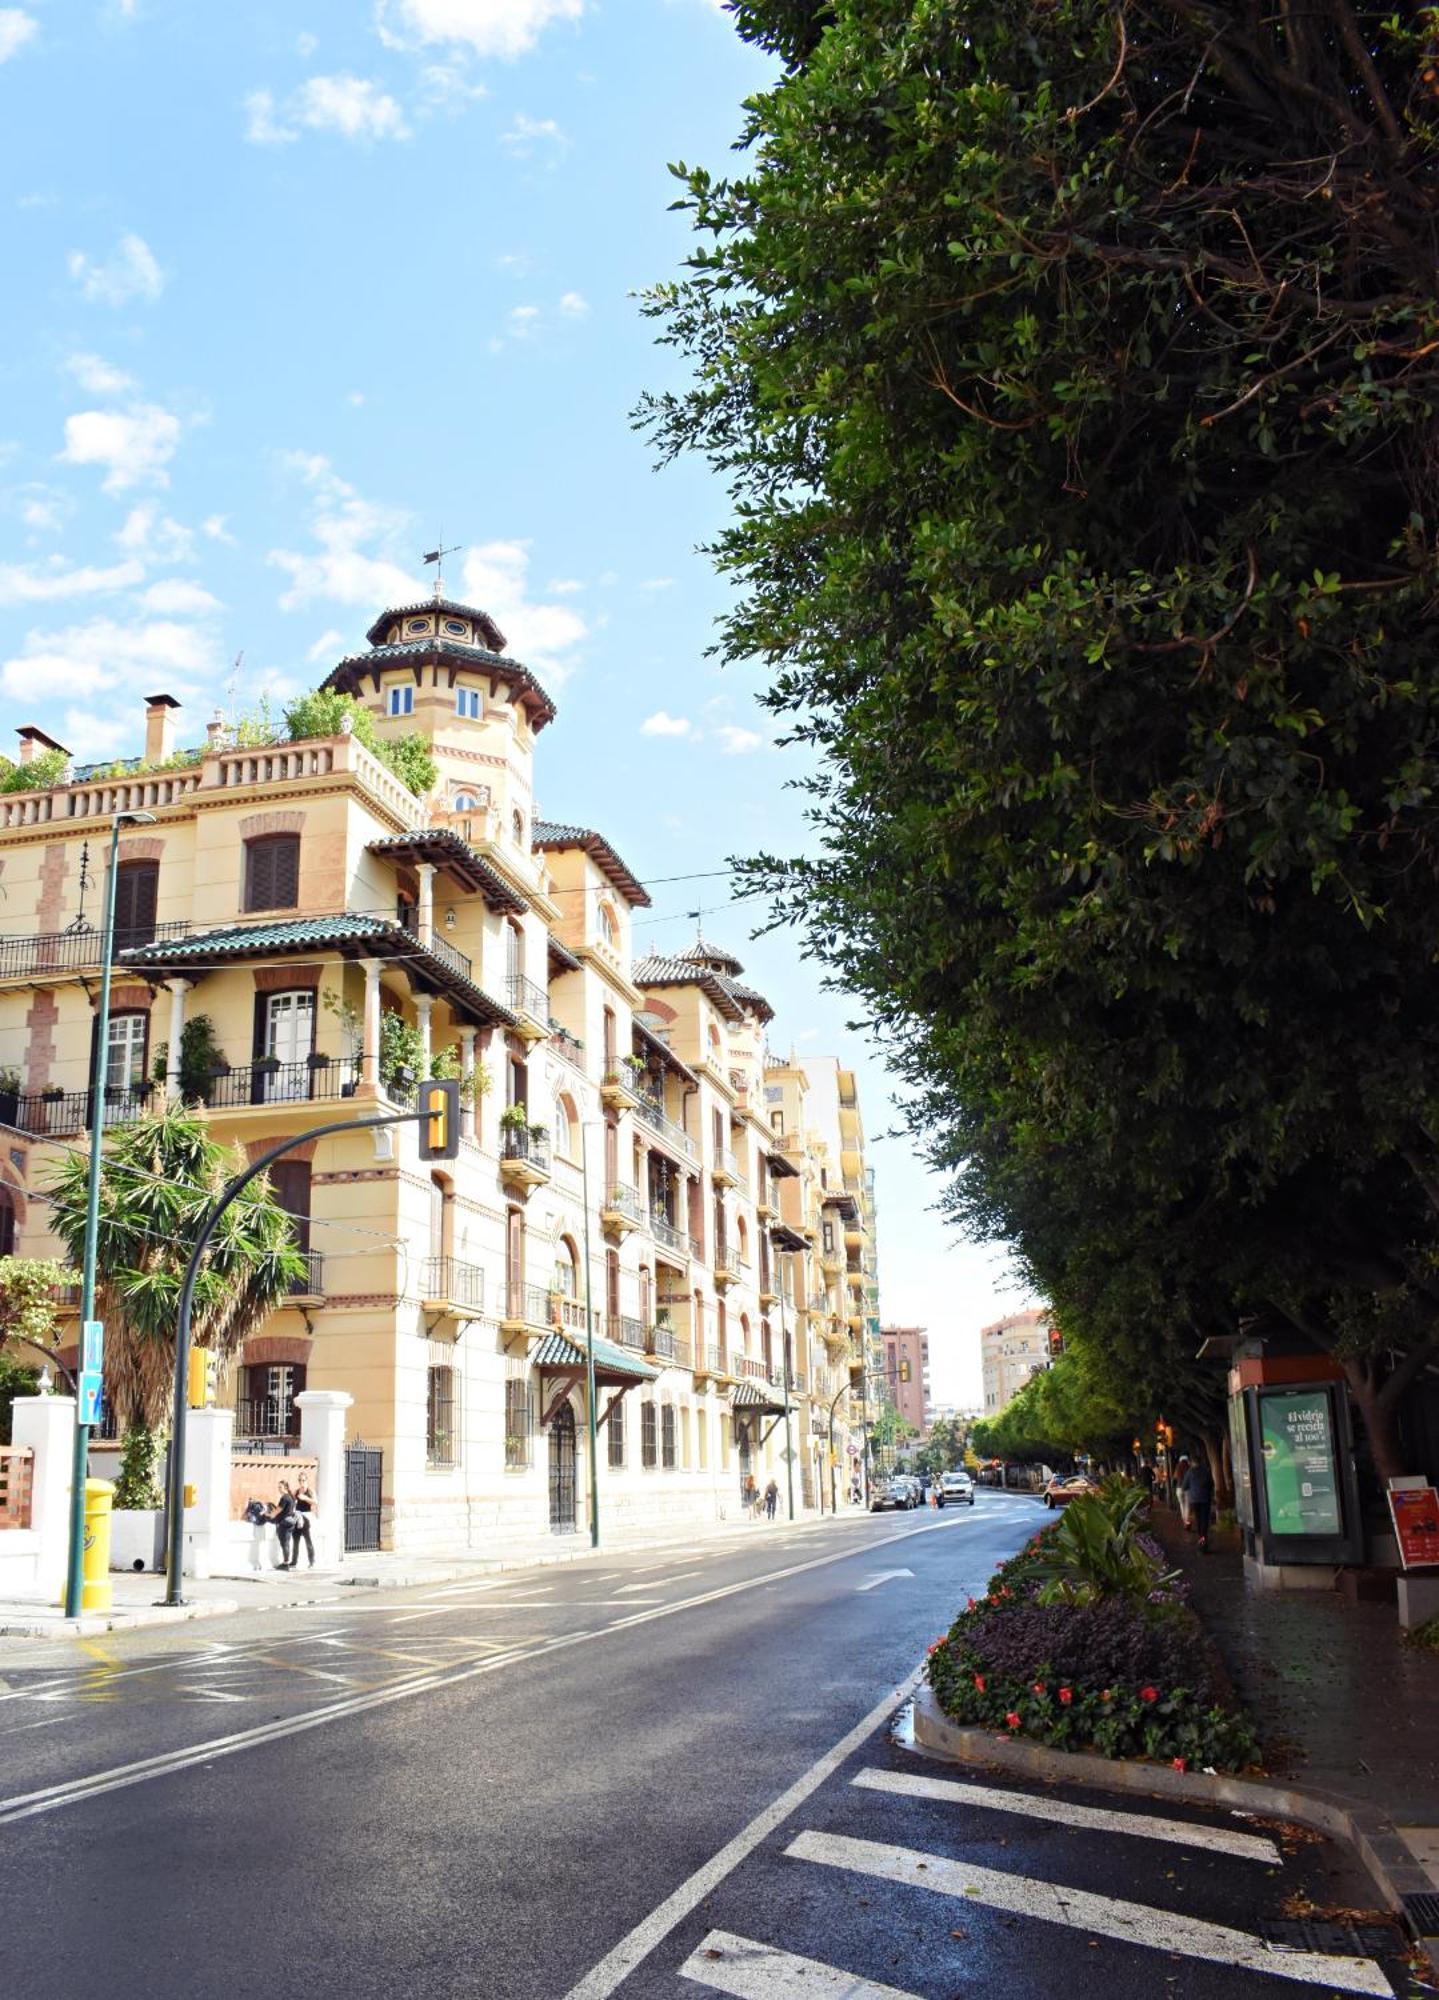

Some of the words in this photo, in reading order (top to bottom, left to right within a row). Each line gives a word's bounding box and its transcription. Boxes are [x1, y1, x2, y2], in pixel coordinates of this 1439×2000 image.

[1298, 1410, 1324, 1421] vidrio
[1286, 1424, 1296, 1432] se
[1297, 1420, 1324, 1432] recicla
[1295, 1431, 1303, 1442] al
